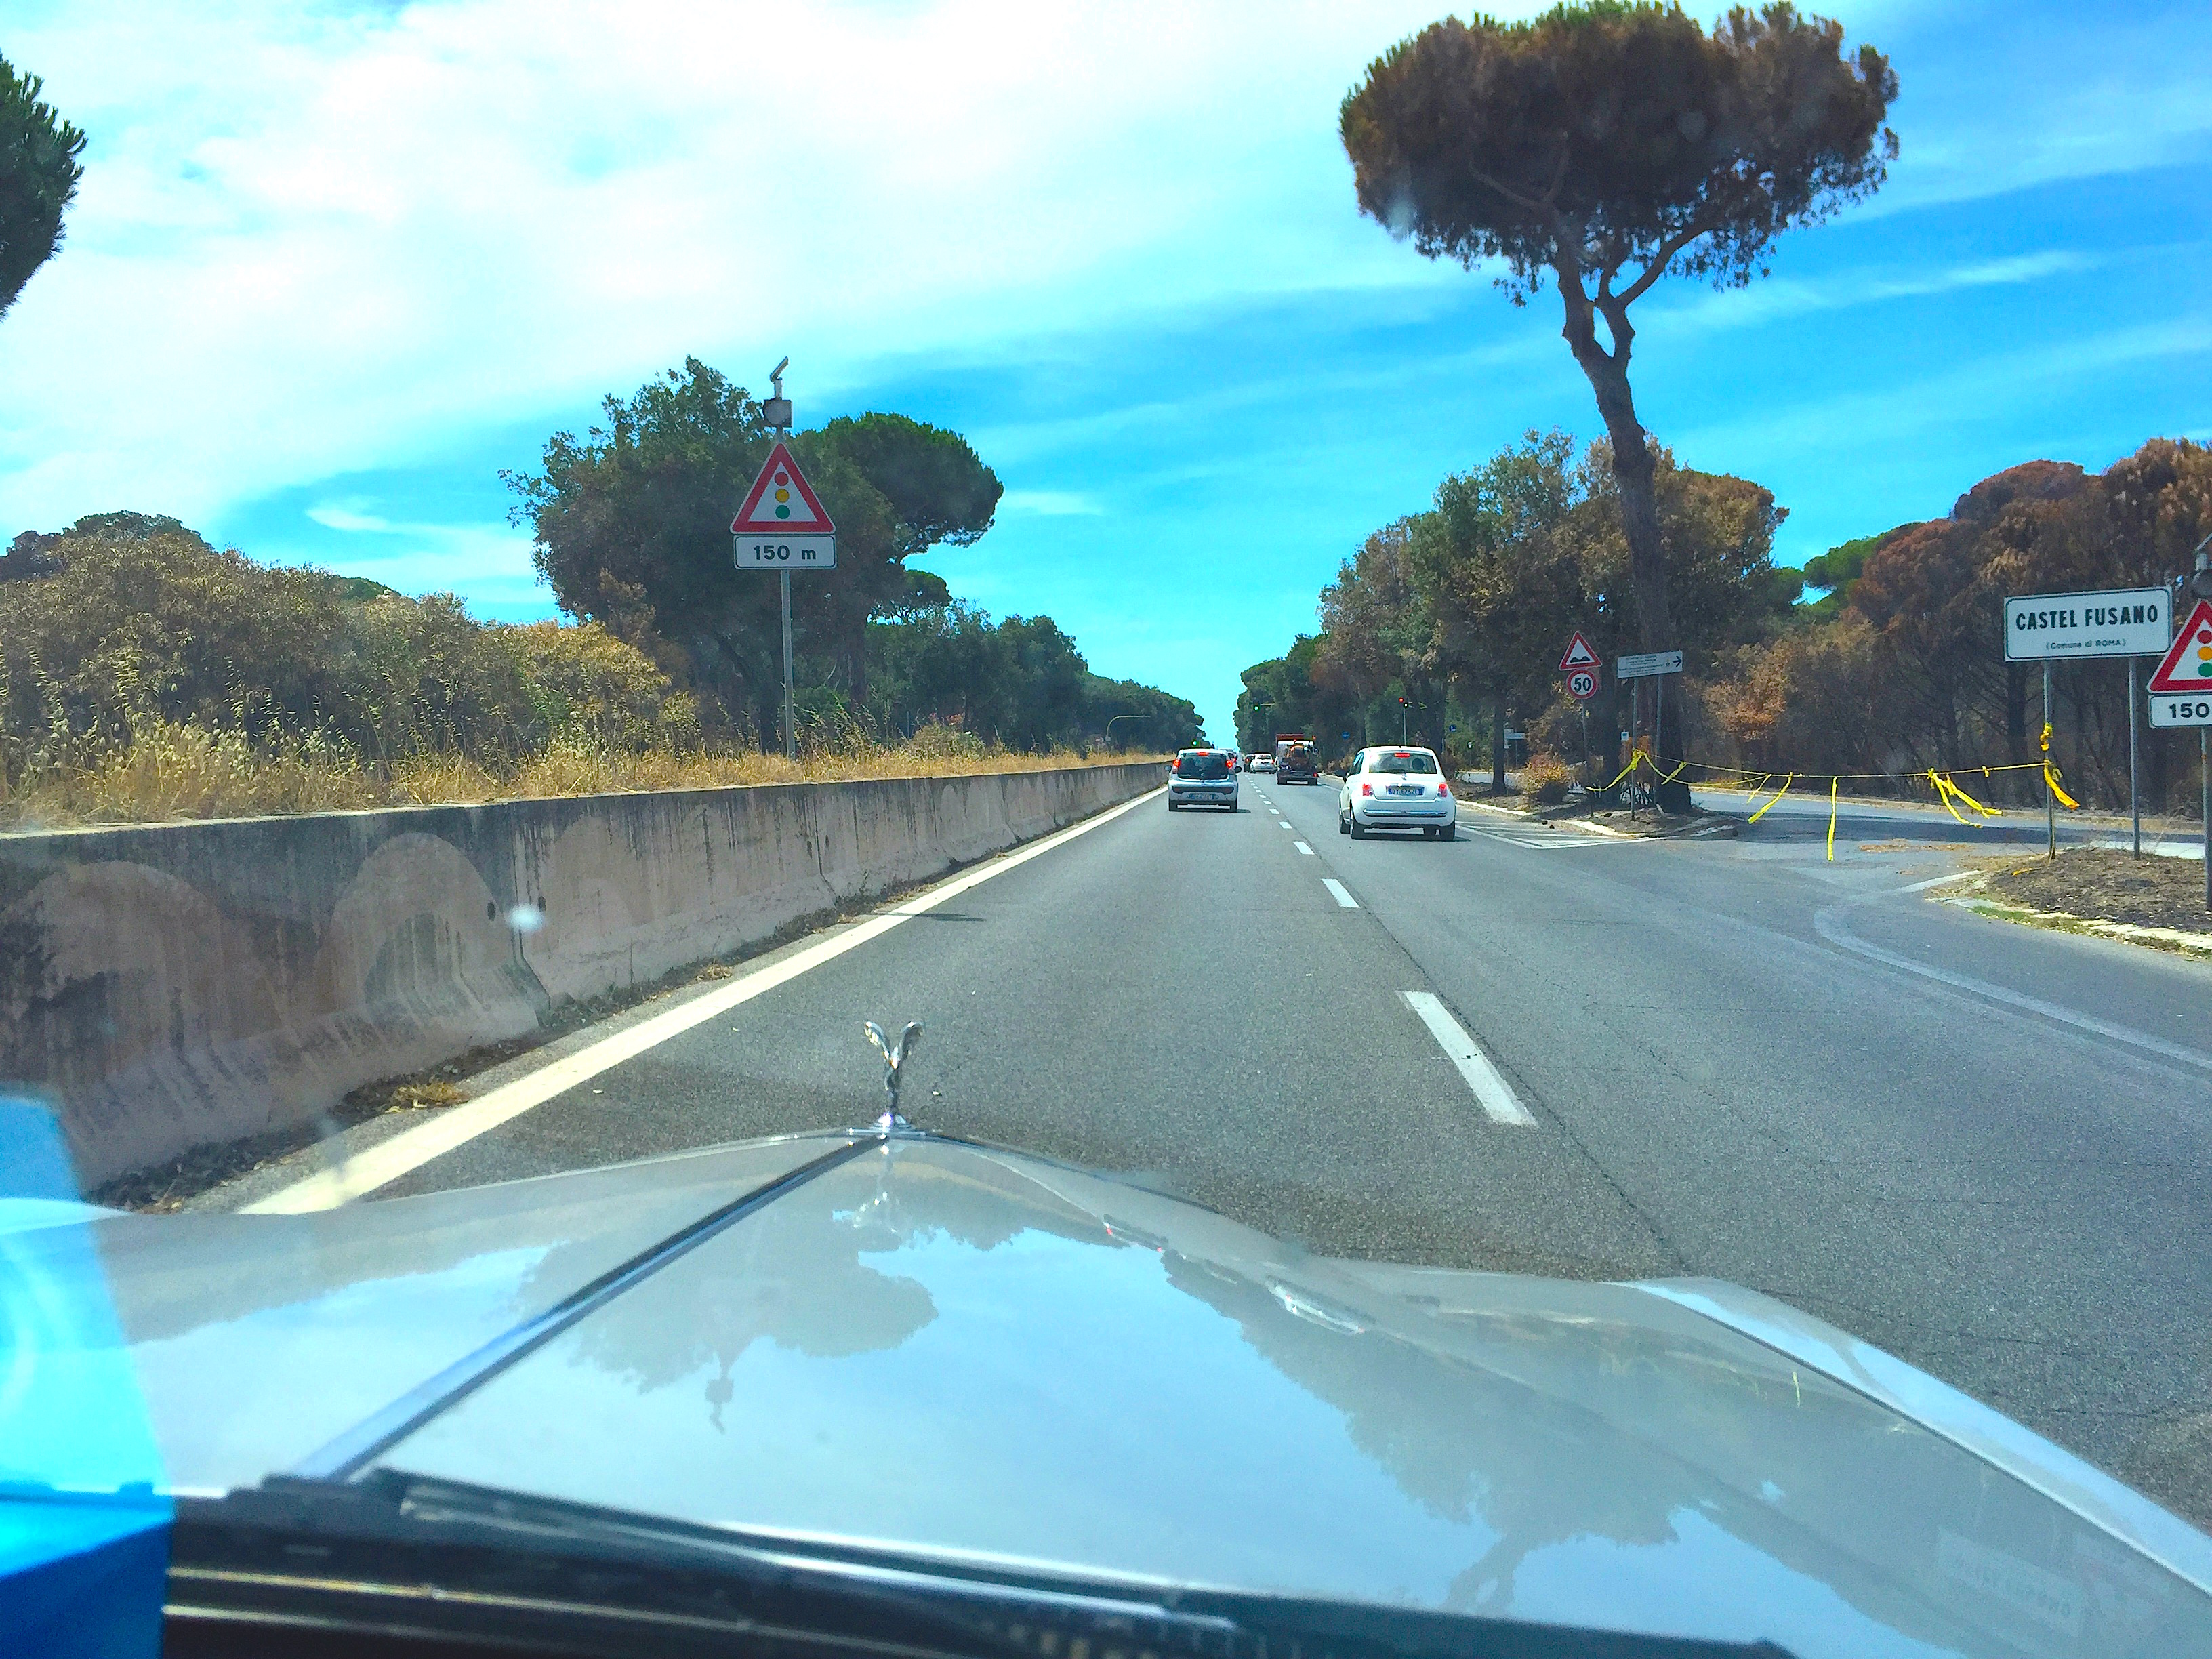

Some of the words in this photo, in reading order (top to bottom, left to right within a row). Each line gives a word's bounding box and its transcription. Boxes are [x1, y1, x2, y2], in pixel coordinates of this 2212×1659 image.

[754, 545, 790, 560] 150
[801, 548, 817, 560] m
[2015, 609, 2078, 630] CASTEL
[2085, 604, 2158, 626] FUSANO
[1574, 676, 1591, 692] 50
[2169, 702, 2210, 718] 150
